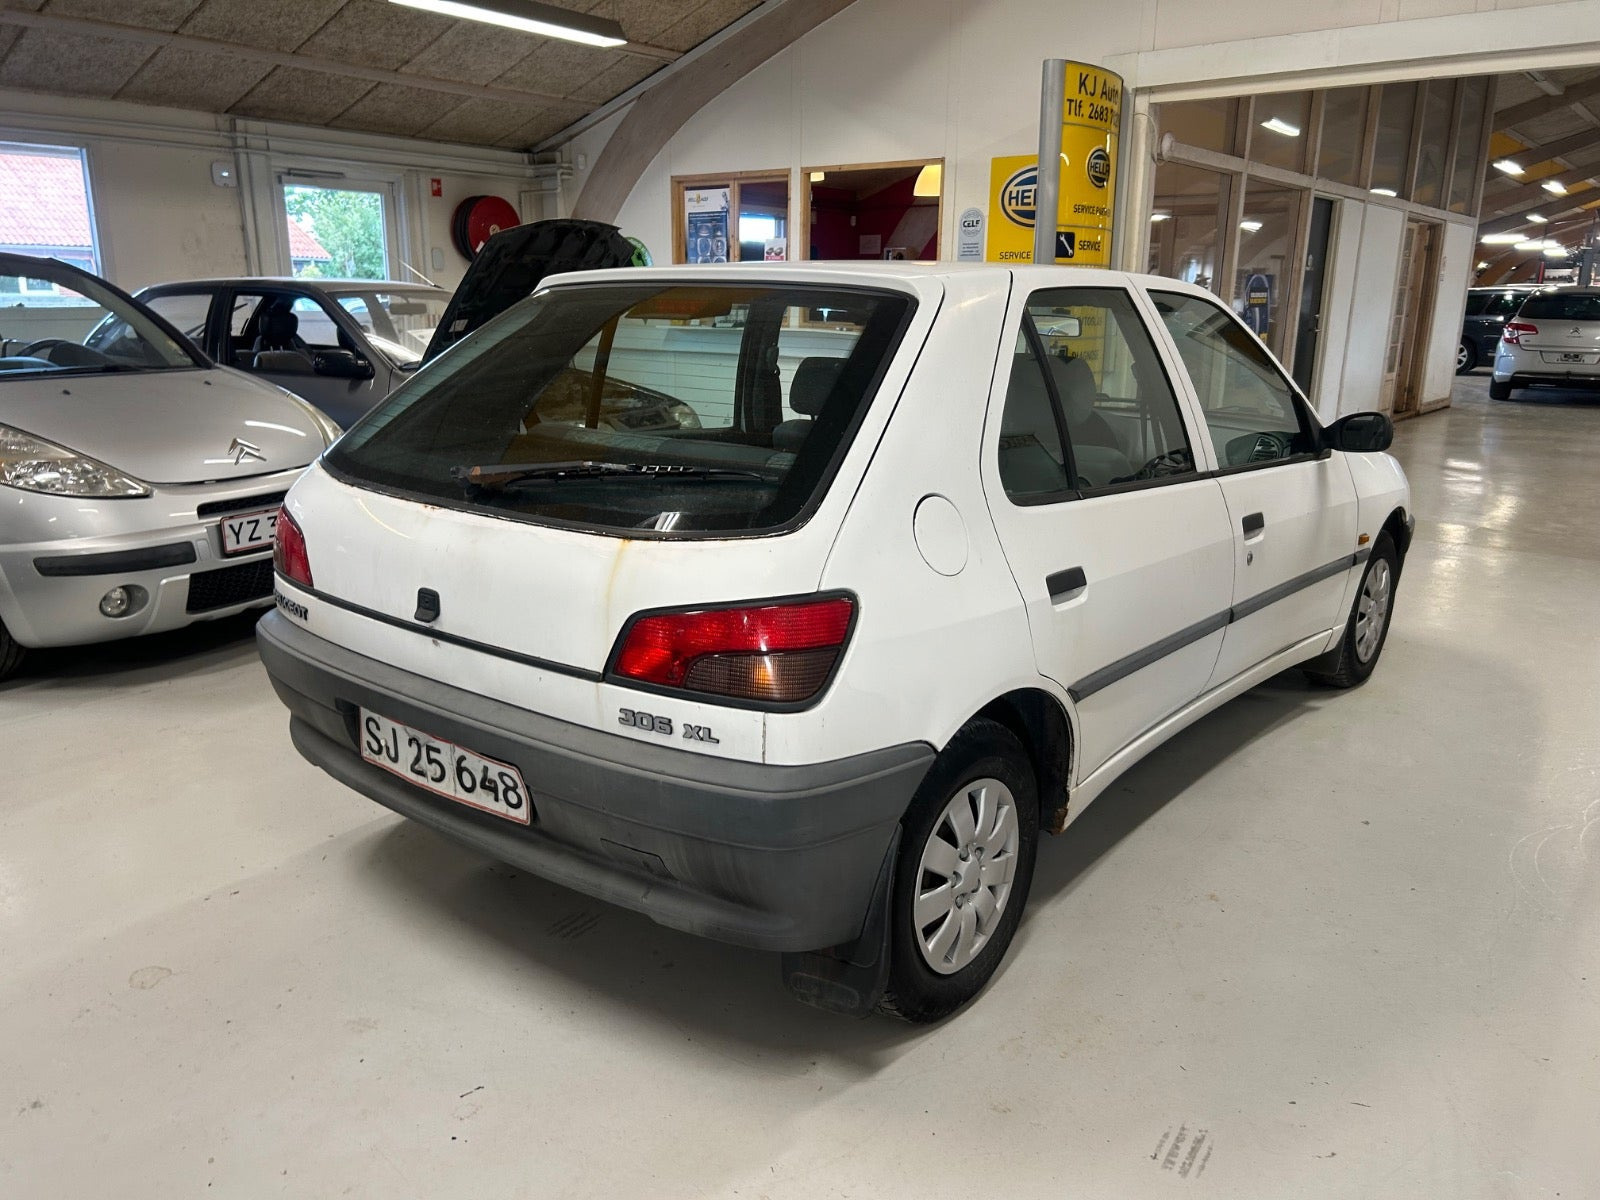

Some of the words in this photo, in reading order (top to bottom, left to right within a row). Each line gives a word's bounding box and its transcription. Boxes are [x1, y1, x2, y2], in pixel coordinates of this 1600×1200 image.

[1078, 72, 1097, 97] KJ
[1066, 98, 1084, 118] Tlf.
[1087, 102, 1109, 123] 2683
[1073, 203, 1095, 215] SERVICE
[999, 250, 1032, 260] SERVICE
[1078, 240, 1101, 252] SERVICE
[228, 518, 262, 545] YZ
[617, 707, 674, 736] 306
[682, 723, 720, 744] XL
[365, 715, 400, 764] SJ
[407, 737, 446, 783] 25
[455, 754, 523, 810] 648
